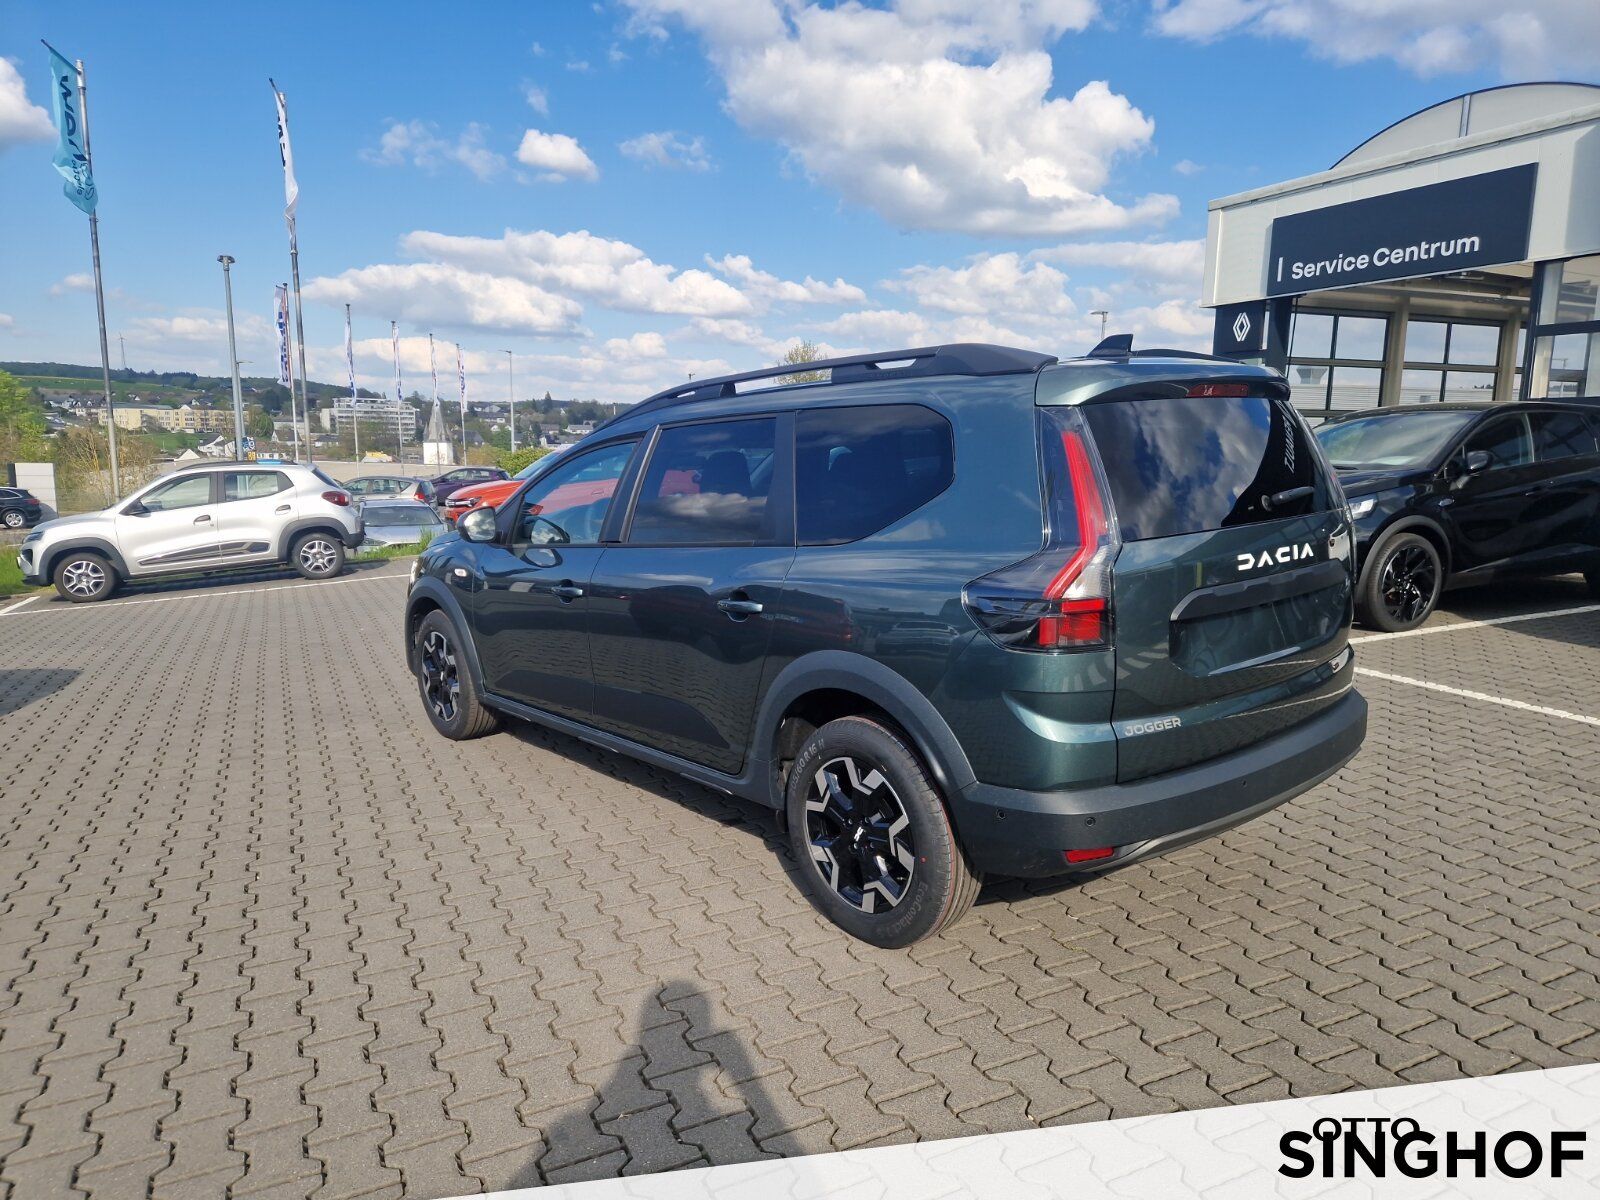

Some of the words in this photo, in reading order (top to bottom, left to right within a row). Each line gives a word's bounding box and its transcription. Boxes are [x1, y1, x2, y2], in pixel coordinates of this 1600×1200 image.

[1291, 253, 1370, 280] Service
[1373, 235, 1480, 267] Centrum
[1237, 542, 1314, 571] DACIA
[1124, 716, 1182, 736] JOGGER
